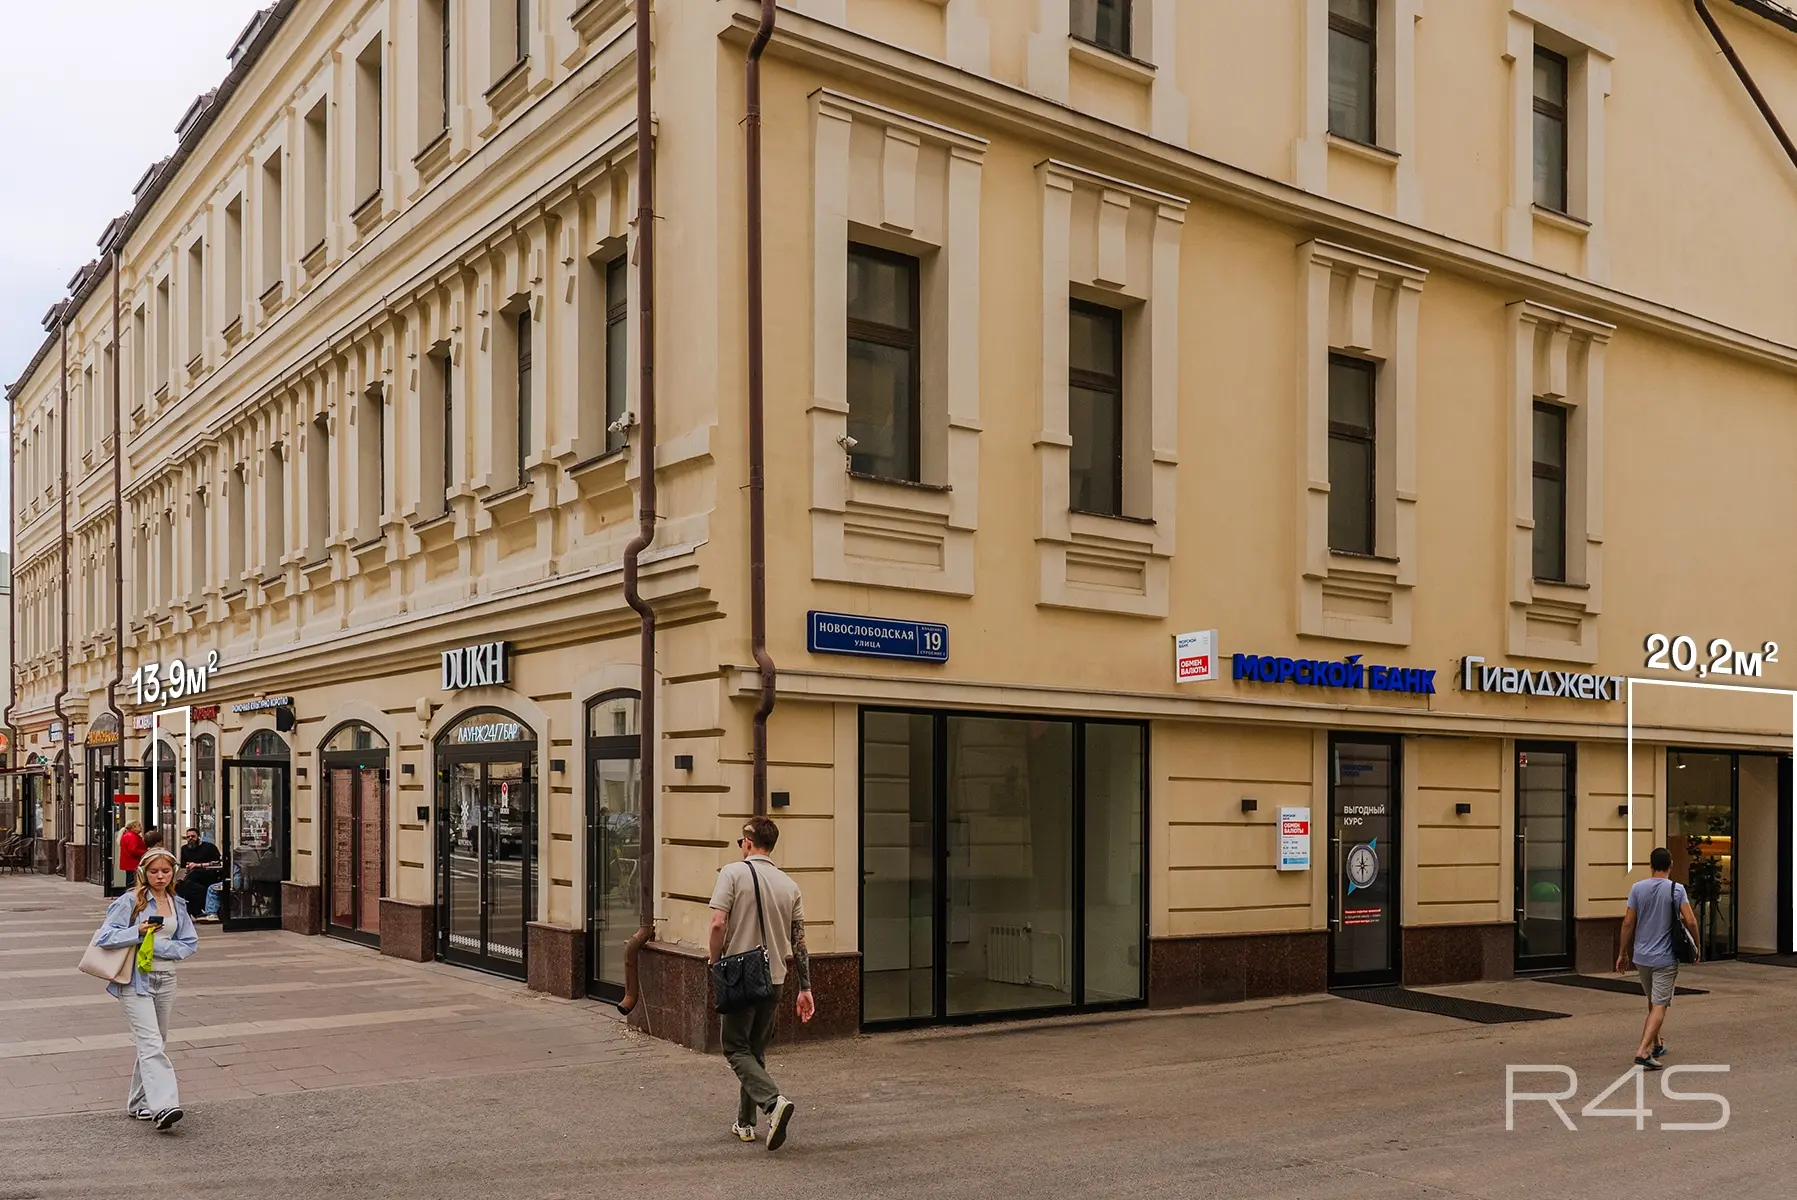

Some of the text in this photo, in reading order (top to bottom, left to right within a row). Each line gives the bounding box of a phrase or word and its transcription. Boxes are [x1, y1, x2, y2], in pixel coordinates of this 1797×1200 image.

[819, 622, 914, 640] НОВОСЛОБОДСКАЯ
[854, 639, 881, 648] УЛИЦА
[924, 632, 942, 651] 19
[441, 641, 504, 691] DUKH
[1181, 658, 1202, 668] ОБМЕН
[1181, 666, 1208, 675] ВАЛЮТЫ
[1233, 653, 1436, 694] МОРСКОЙ БАНК
[1461, 655, 1625, 700] Гиалджект
[457, 725, 484, 742] ЛАУНЖ
[503, 723, 518, 740] БАР
[1344, 804, 1385, 816] ВЫГОДНЫЙ
[1344, 818, 1363, 826] КУРС
